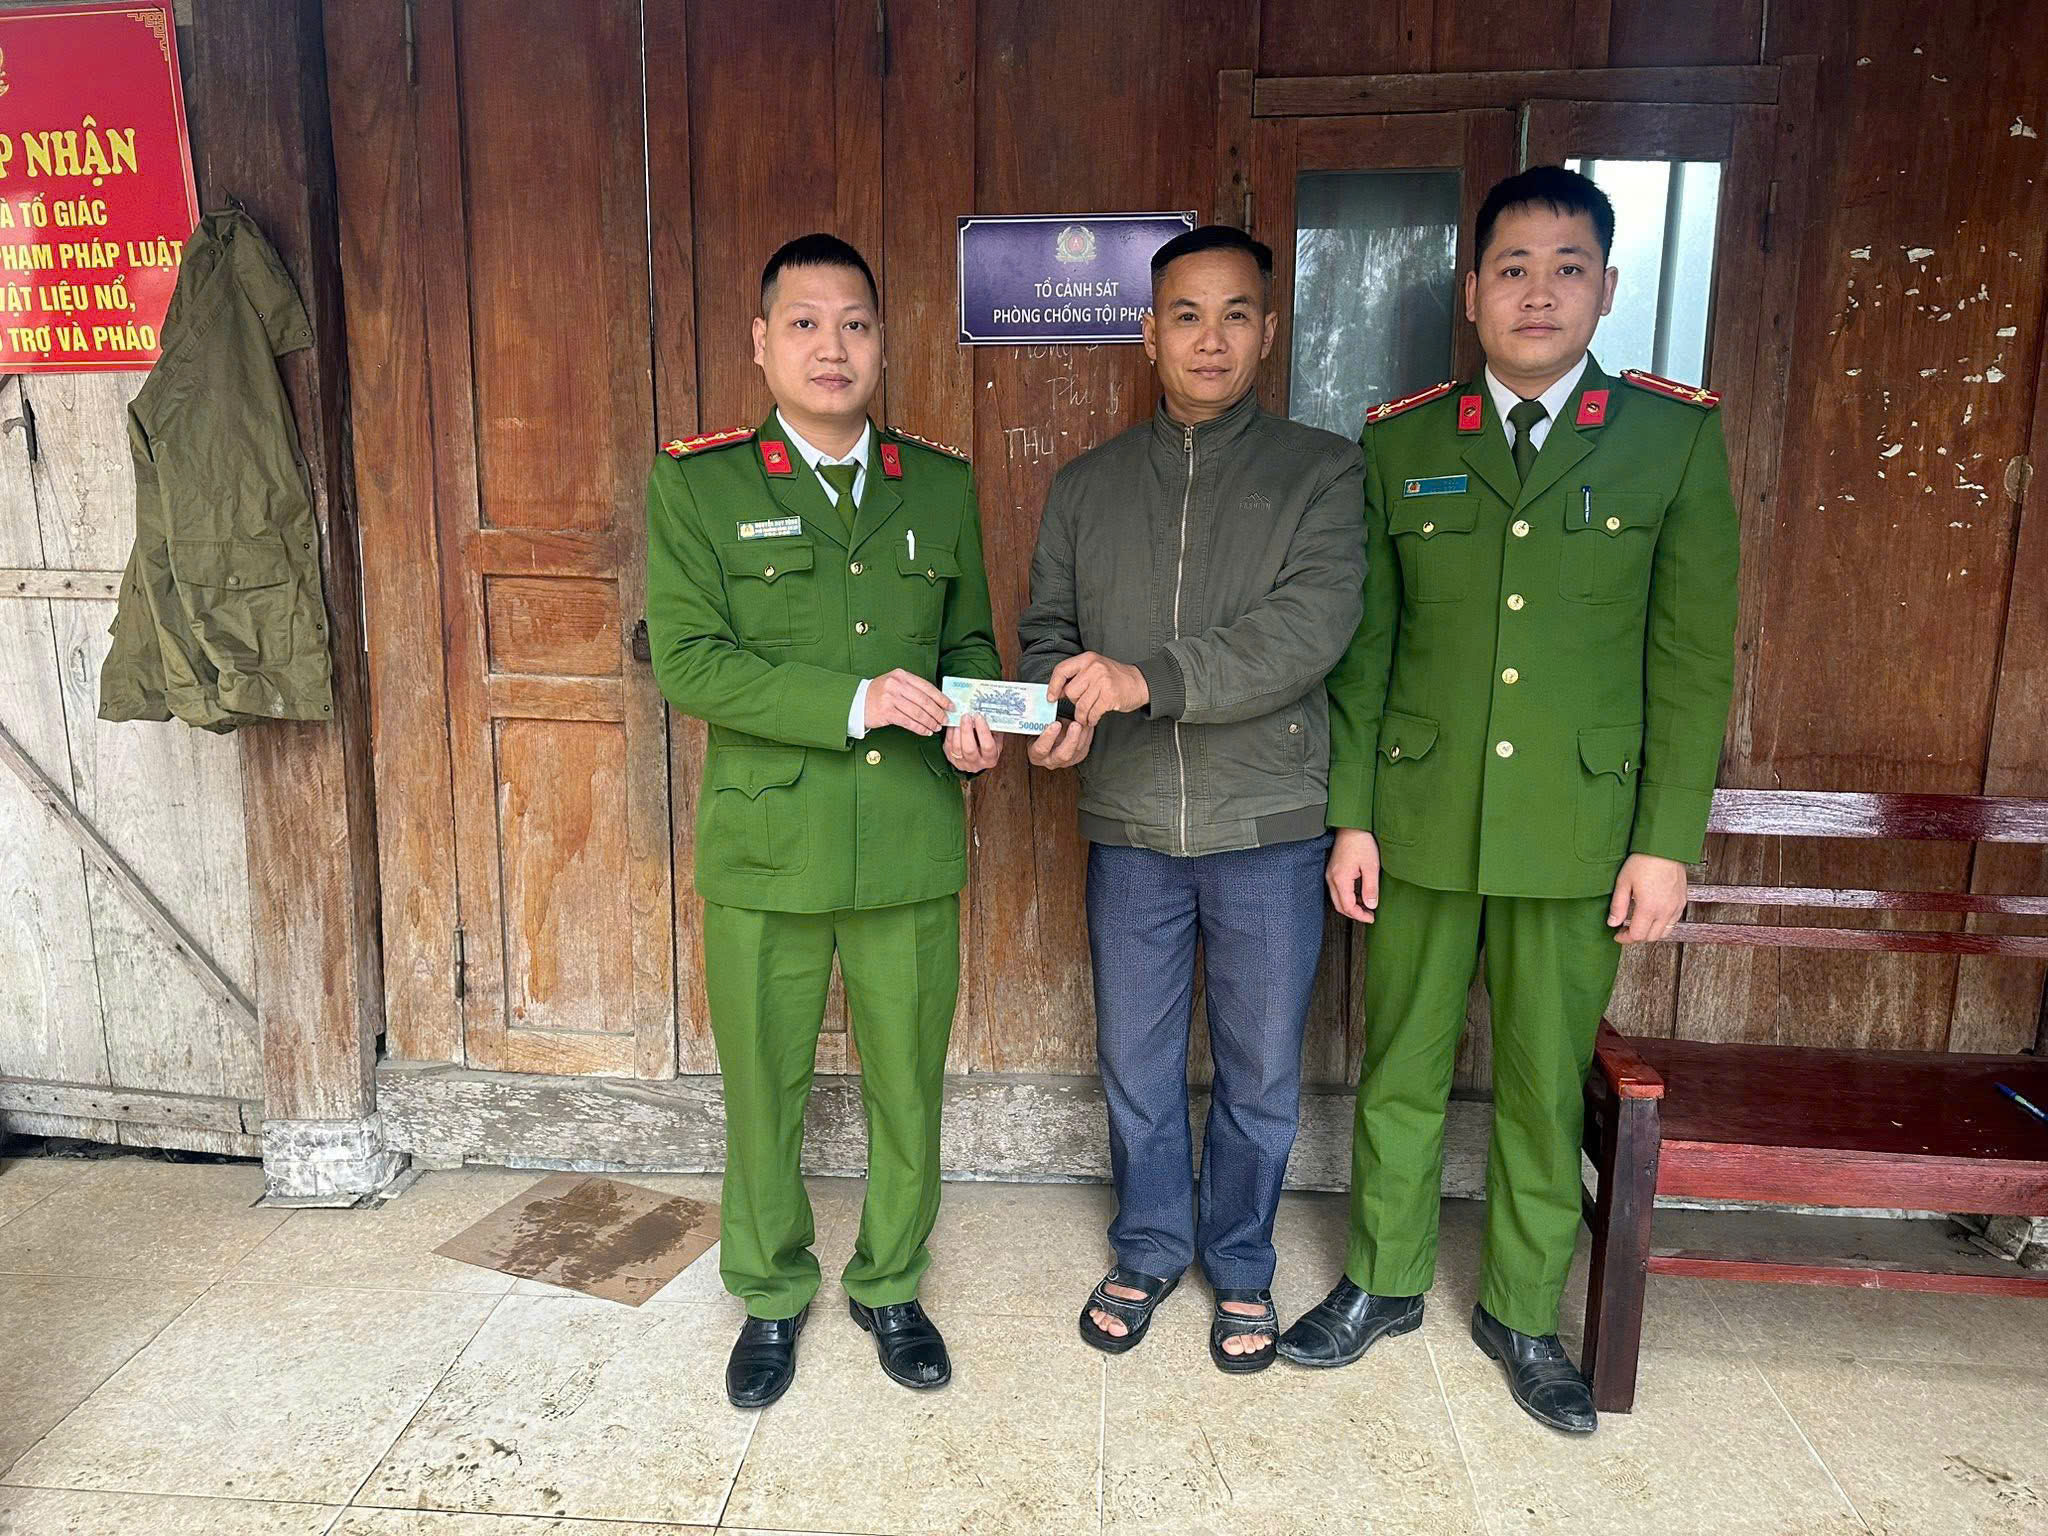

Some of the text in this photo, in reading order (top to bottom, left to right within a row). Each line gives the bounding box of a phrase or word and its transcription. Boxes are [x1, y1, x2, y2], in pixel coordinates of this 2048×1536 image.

[21, 115, 138, 186] NHẬN
[18, 191, 48, 228] TỐ
[53, 194, 108, 227] GIÁC
[0, 235, 183, 276] HẠM PHÁP LUẬT
[38, 279, 89, 317] LIỆU
[93, 273, 137, 313] NỔ,
[1034, 276, 1120, 298] TỔ CẢNH SÁT
[993, 304, 1041, 324] PHÒNG
[1044, 302, 1092, 323] CHỐNG
[1094, 304, 1116, 325] TỘI
[6, 324, 52, 358] TRỢ
[55, 320, 89, 352] VÀ
[92, 320, 156, 351] PHÁO
